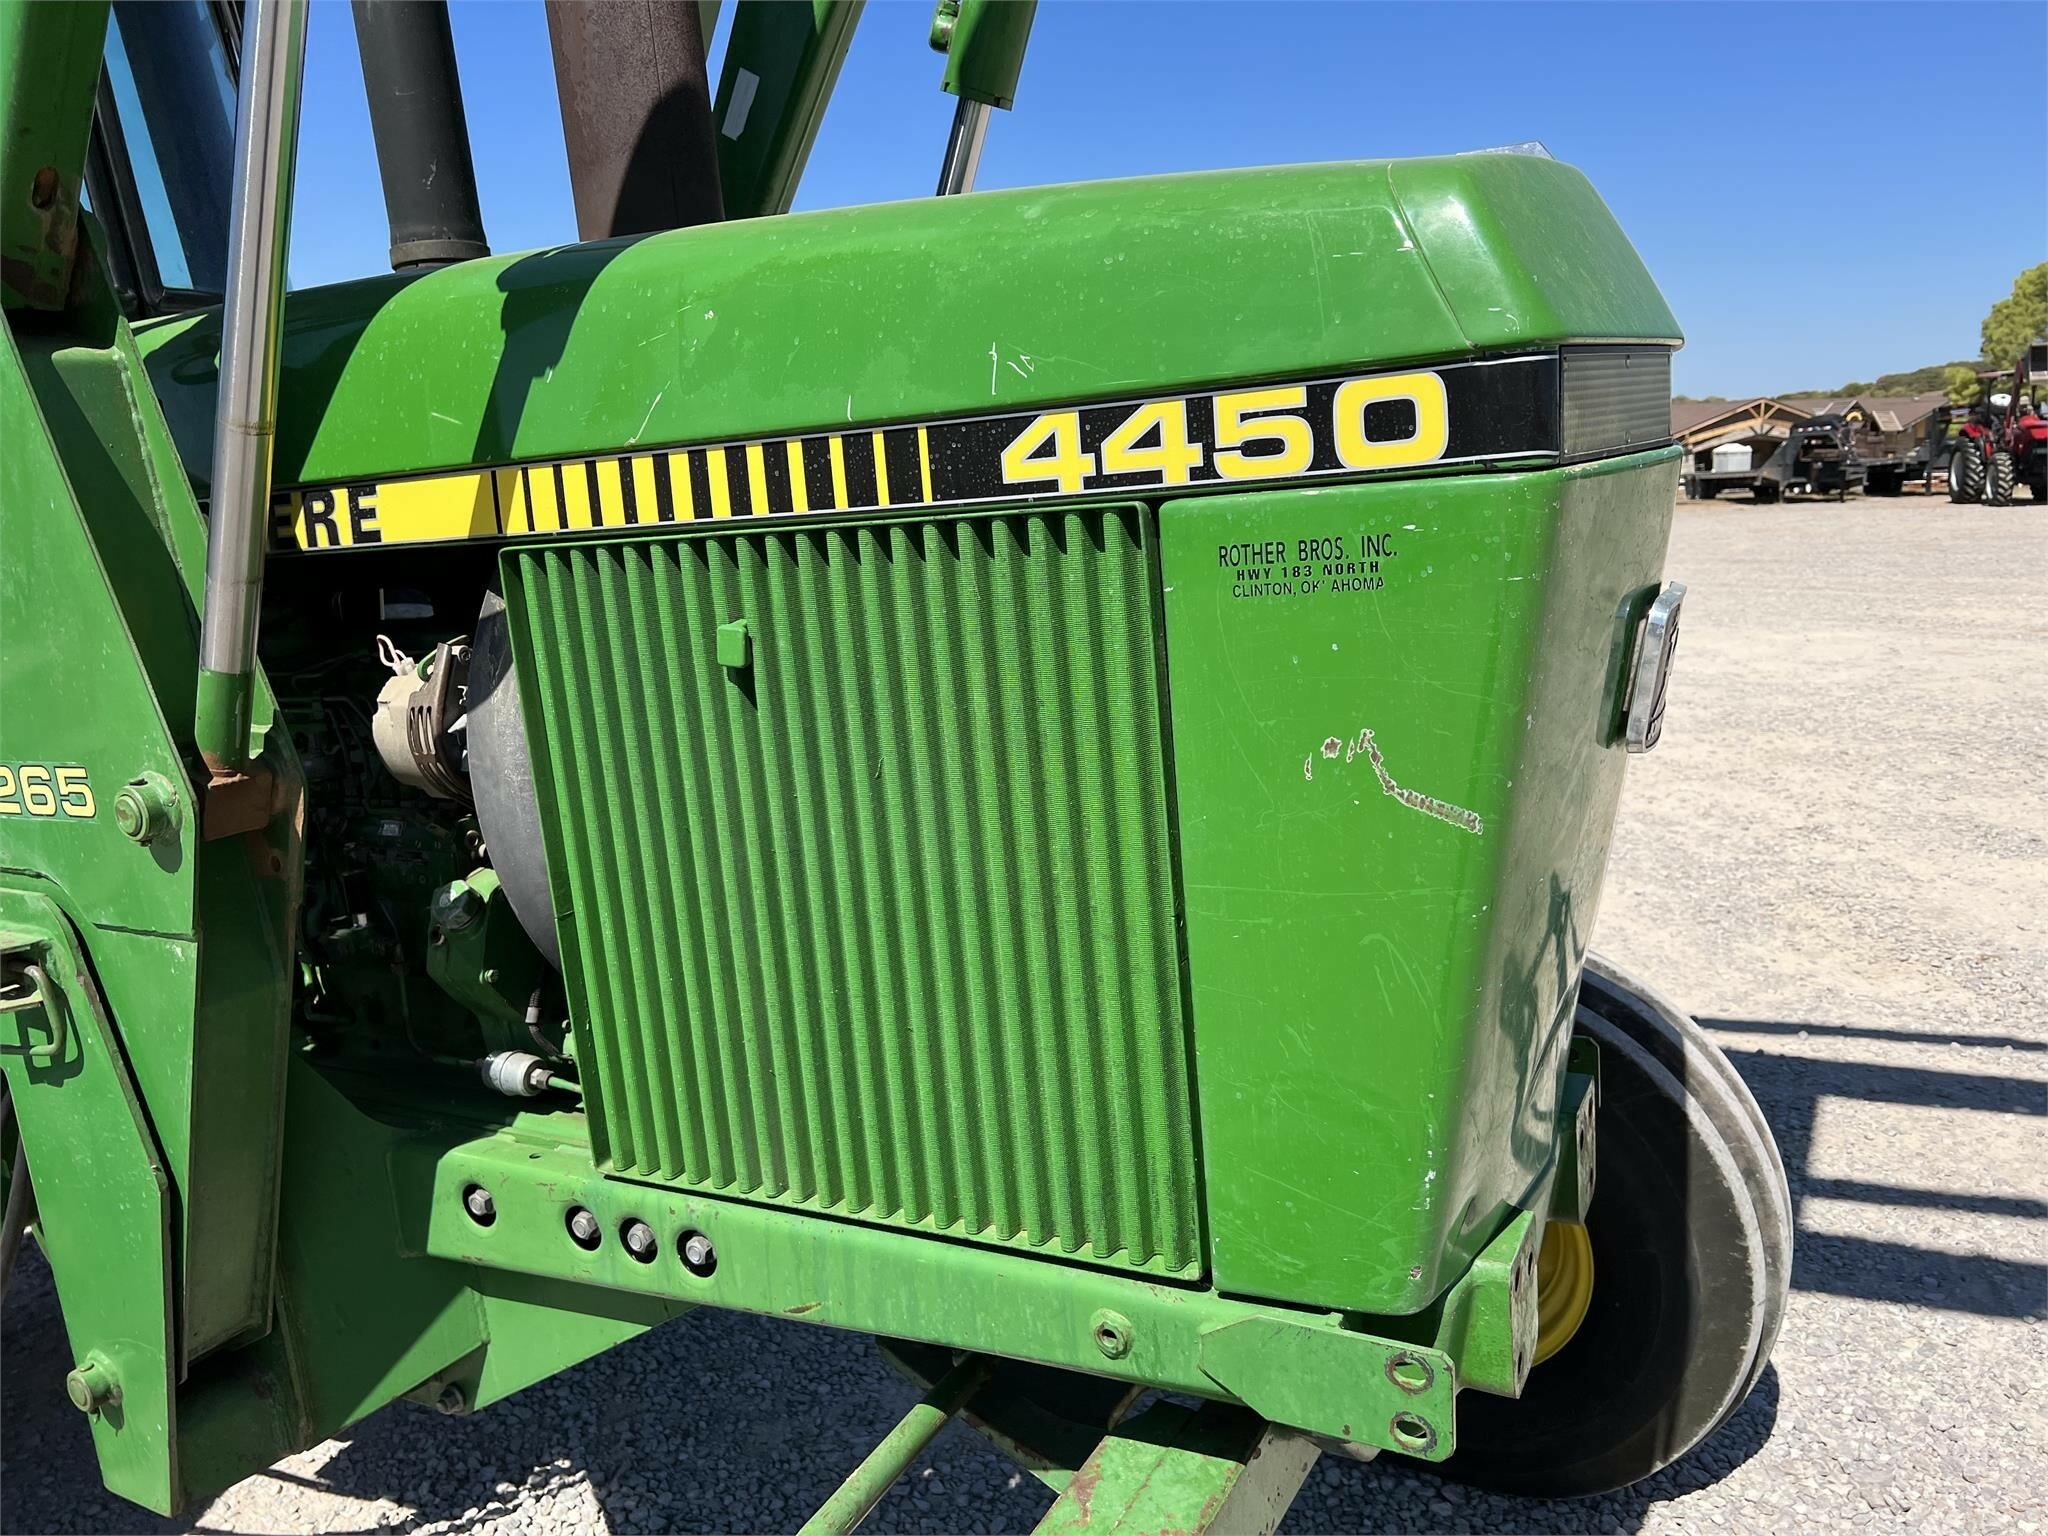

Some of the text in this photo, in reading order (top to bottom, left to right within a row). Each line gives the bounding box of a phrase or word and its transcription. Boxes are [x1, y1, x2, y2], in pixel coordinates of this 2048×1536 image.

[1000, 371, 1449, 494] 4450
[1219, 541, 1286, 567] ROTHER
[1361, 533, 1398, 558] INC.
[1236, 561, 1379, 581] HWY 183 NORTH
[1232, 582, 1297, 598] CLINTON,
